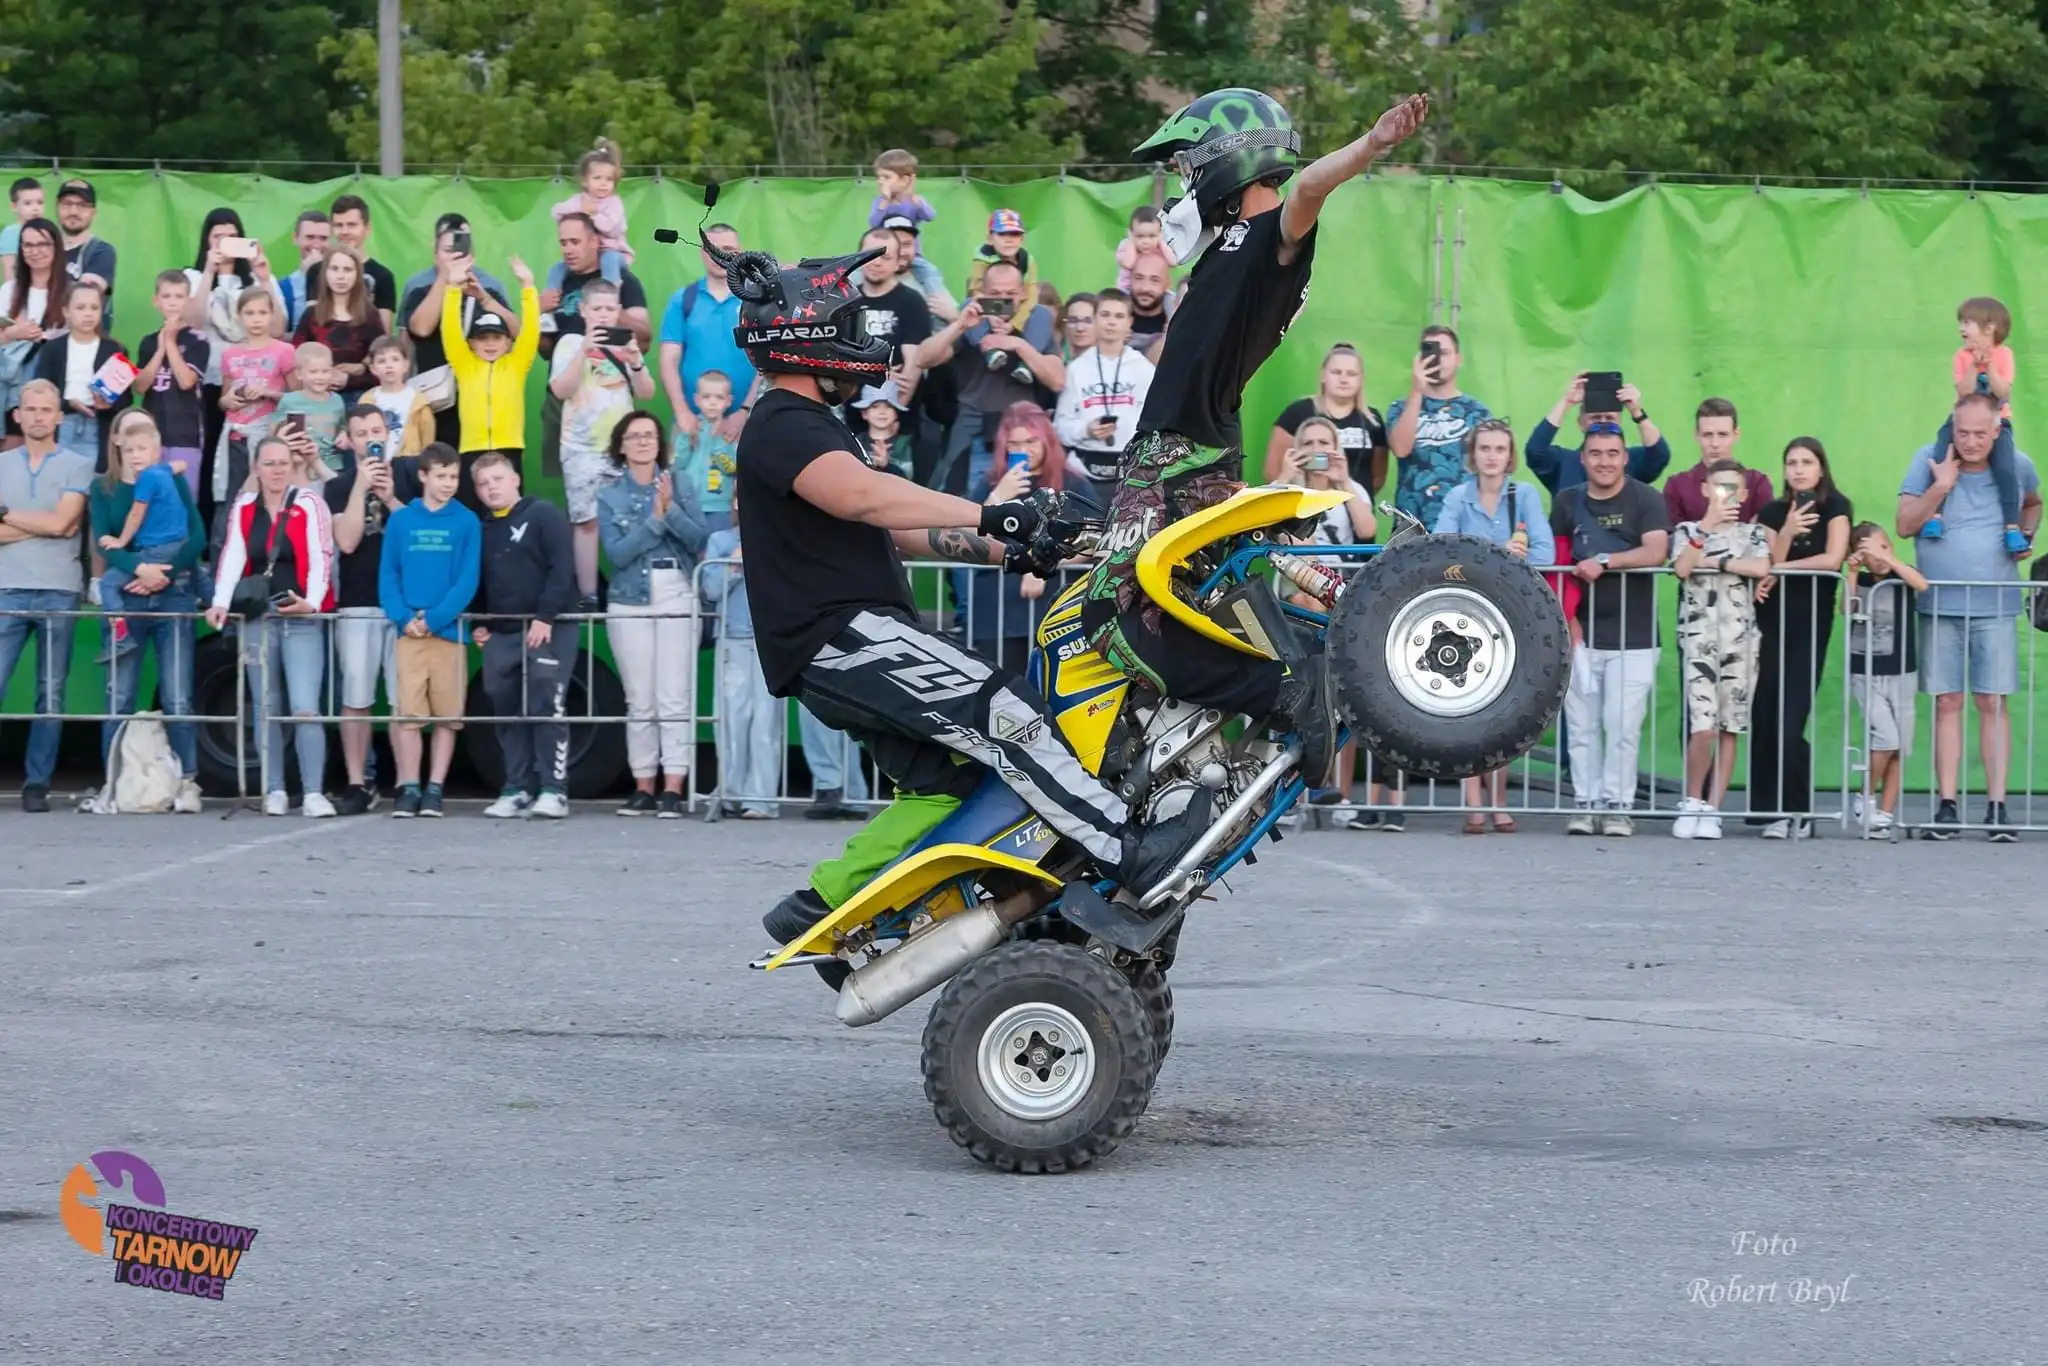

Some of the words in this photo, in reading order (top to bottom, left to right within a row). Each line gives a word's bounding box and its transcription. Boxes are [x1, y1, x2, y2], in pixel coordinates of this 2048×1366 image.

[747, 325, 837, 344] ALFARAD
[1057, 635, 1091, 661] SU
[921, 711, 1032, 782] RACING
